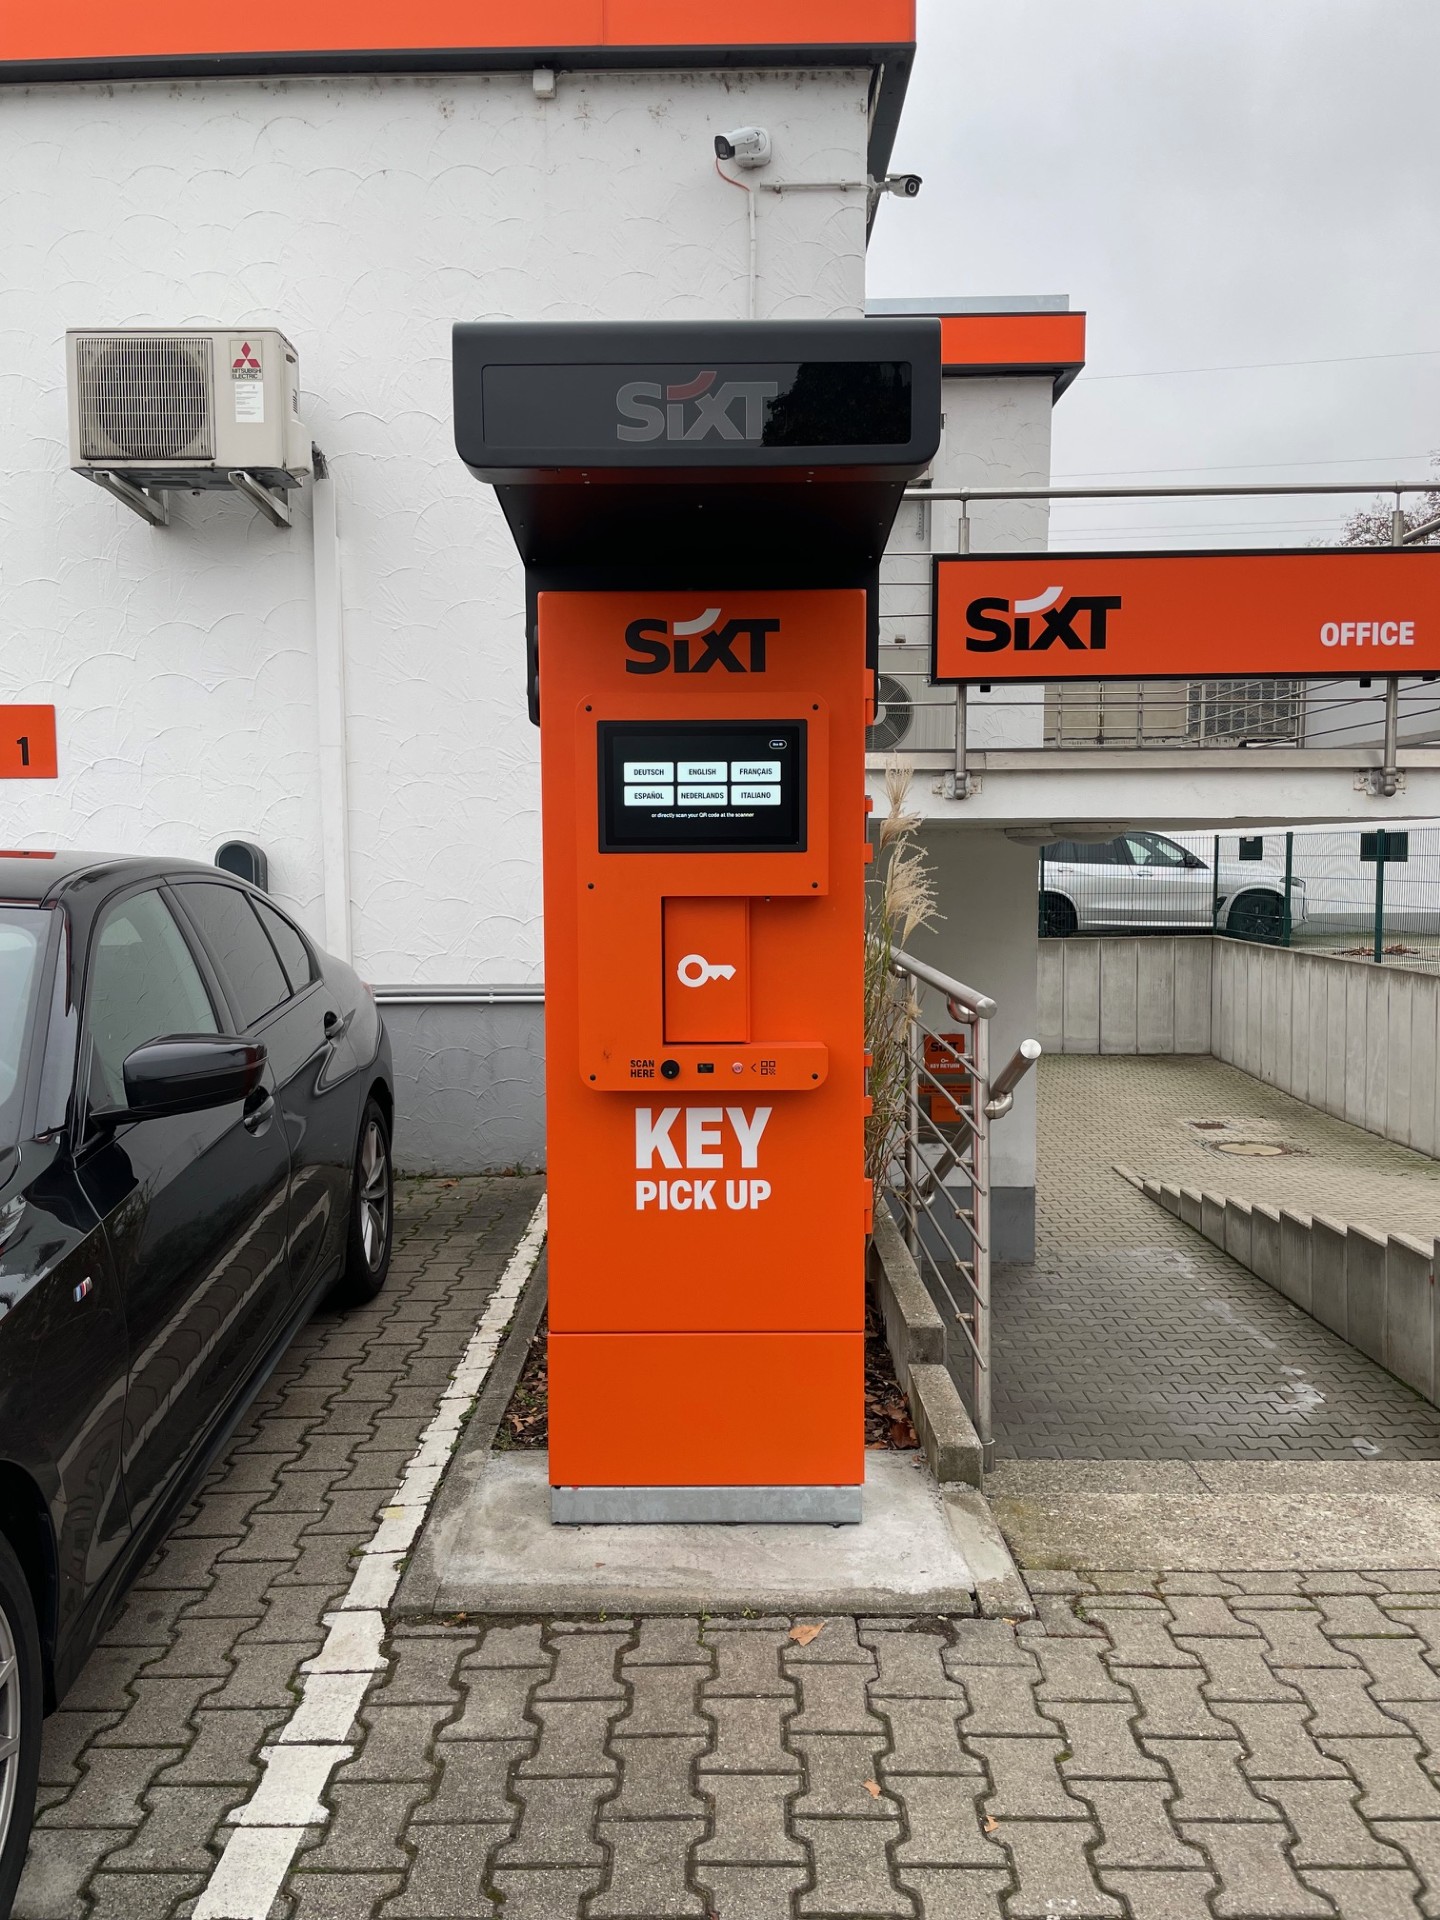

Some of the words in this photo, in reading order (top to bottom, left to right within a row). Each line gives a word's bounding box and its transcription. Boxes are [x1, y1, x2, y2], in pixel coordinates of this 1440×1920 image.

[1320, 621, 1415, 647] OFFICE
[16, 736, 30, 766] 1
[739, 768, 773, 776] FRANÇAIS
[634, 791, 664, 800] ESPAÑOL
[680, 792, 725, 800] NEDERLANDS
[740, 791, 772, 799] ITALIANO
[630, 1059, 655, 1068] SCAN
[630, 1069, 655, 1078] HERE
[635, 1107, 773, 1169] KEY
[635, 1179, 717, 1211] PICK
[726, 1179, 772, 1210] UP
